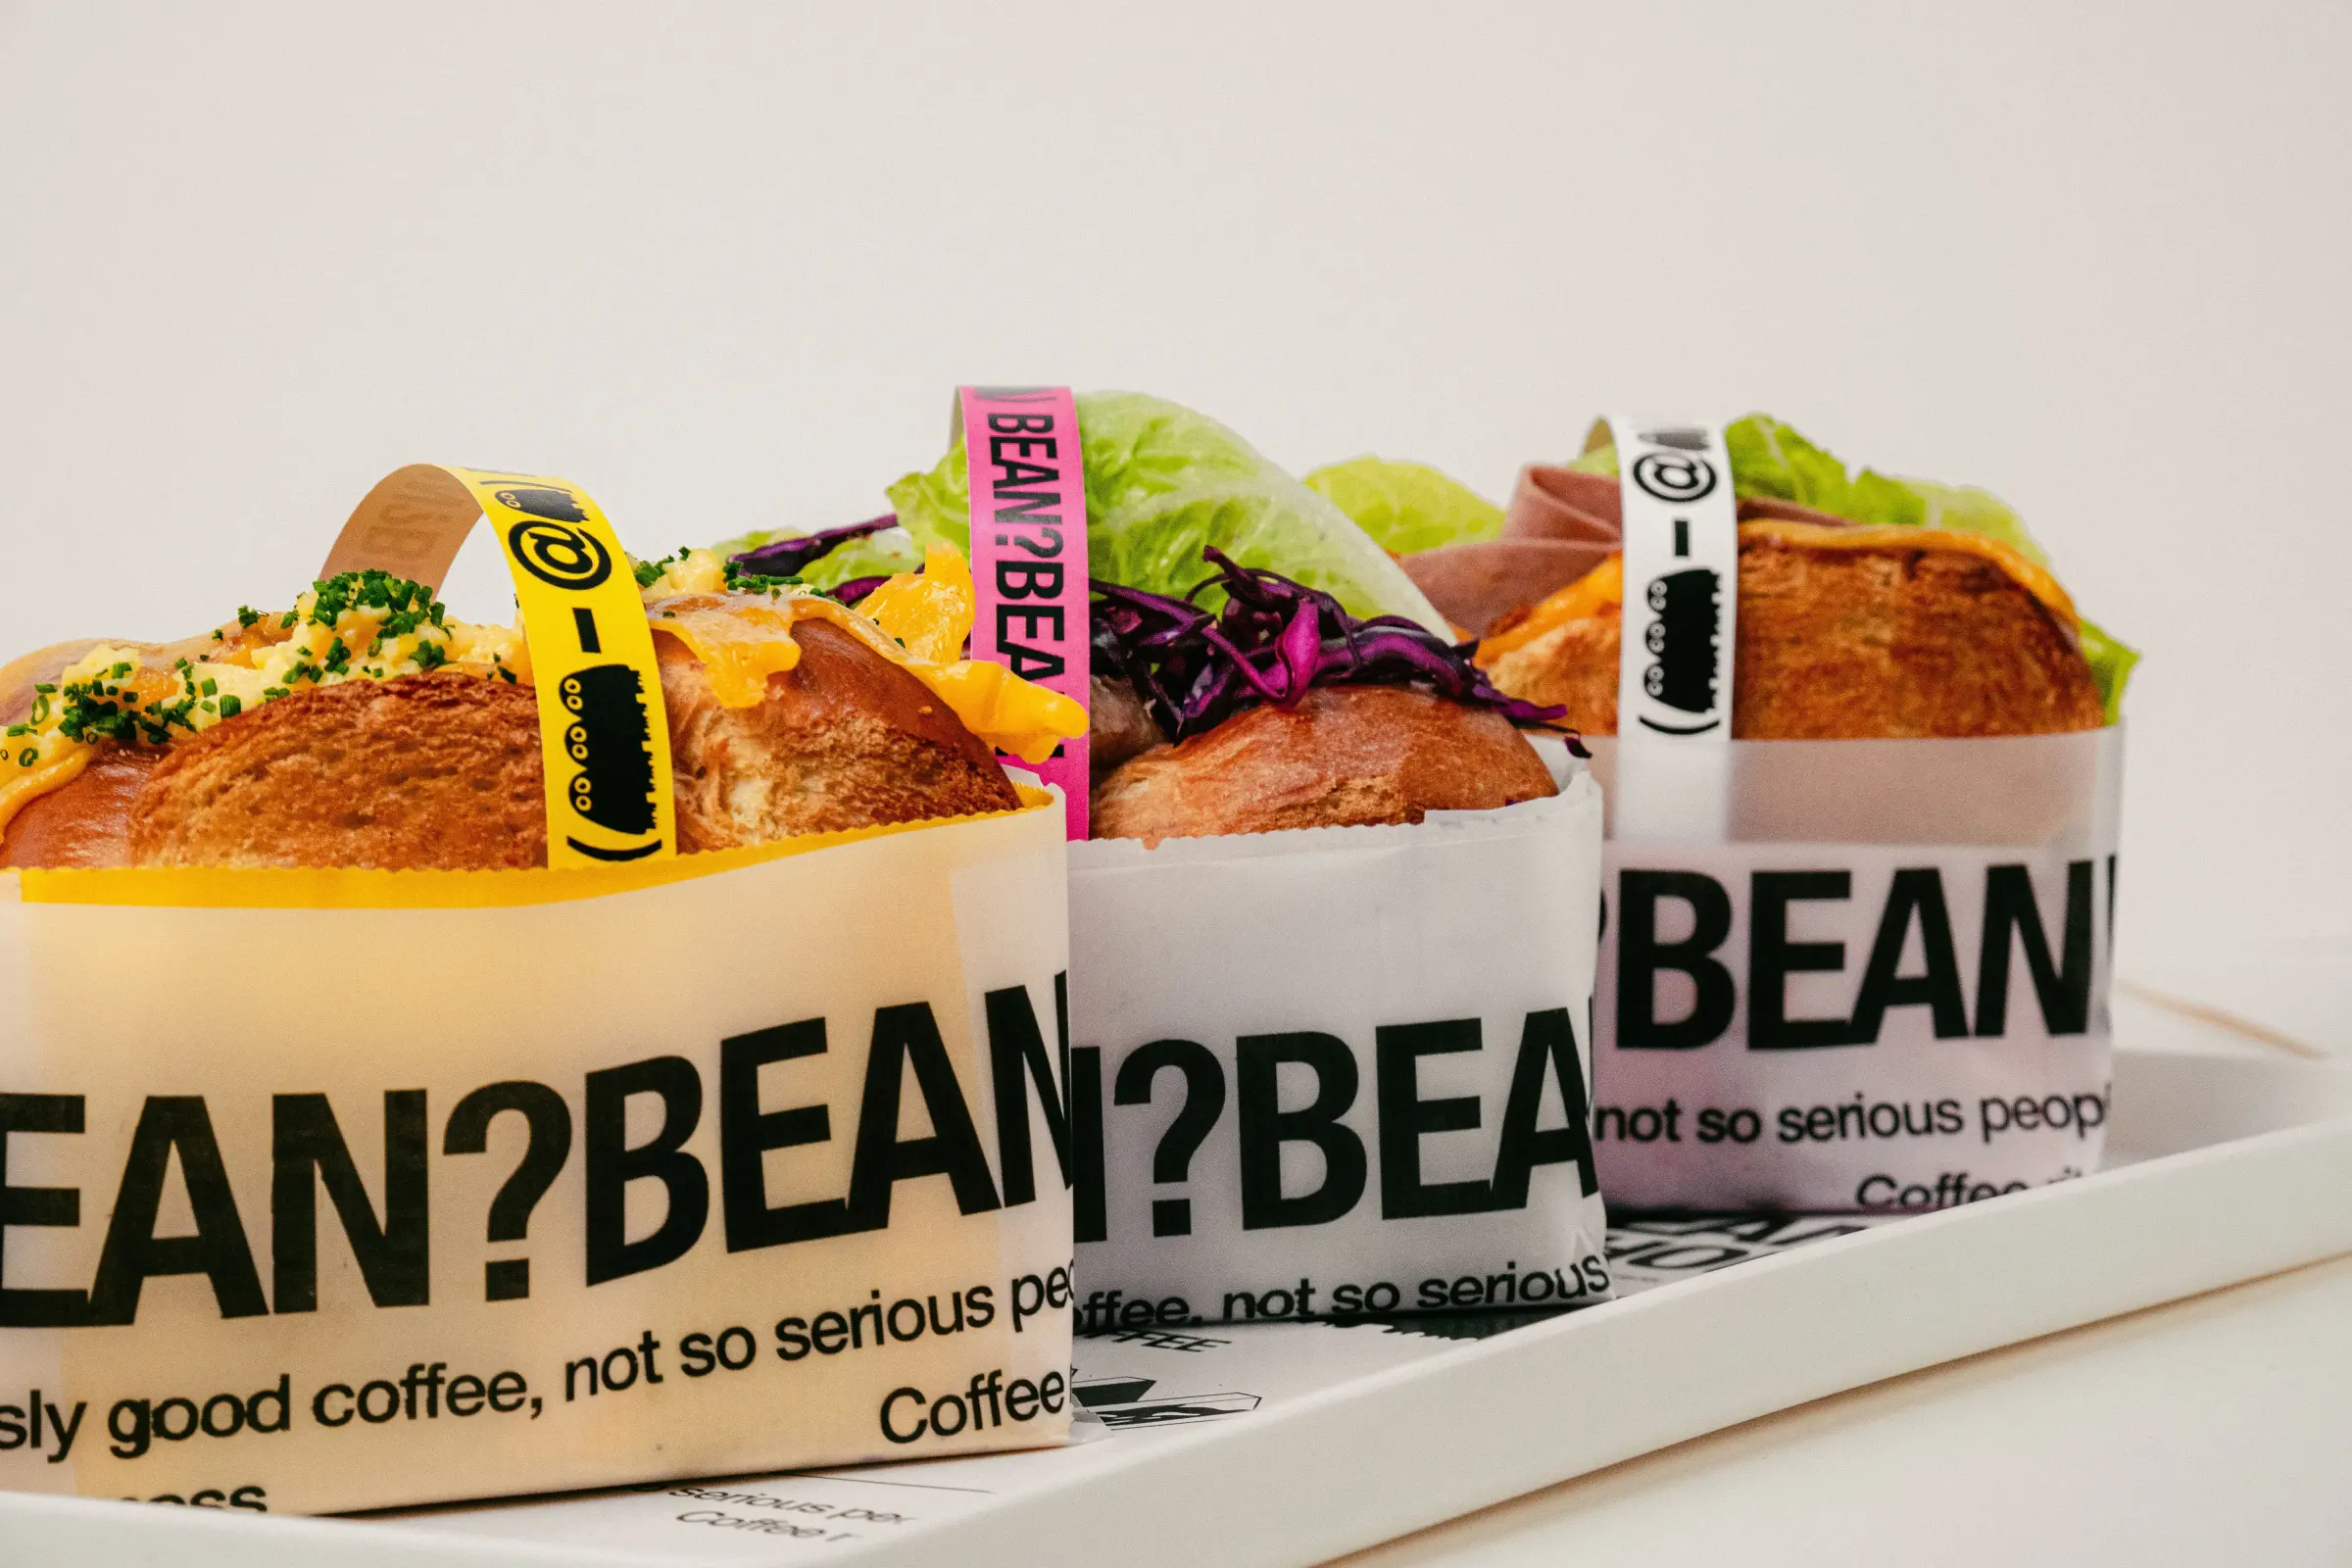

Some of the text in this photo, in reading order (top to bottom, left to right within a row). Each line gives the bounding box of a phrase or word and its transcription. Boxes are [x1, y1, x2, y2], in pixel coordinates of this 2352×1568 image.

[988, 413, 1065, 760] BEAN?BEA
[1599, 855, 2116, 1053] BEAN
[1593, 1083, 2110, 1146] not so serious peop
[1223, 1278, 1316, 1319] not
[1331, 1284, 1400, 1314] so
[1417, 1260, 1610, 1308] serious
[0, 1258, 1074, 1464] sly good coffee, not so serious pe
[879, 1368, 1065, 1445] Coffee
